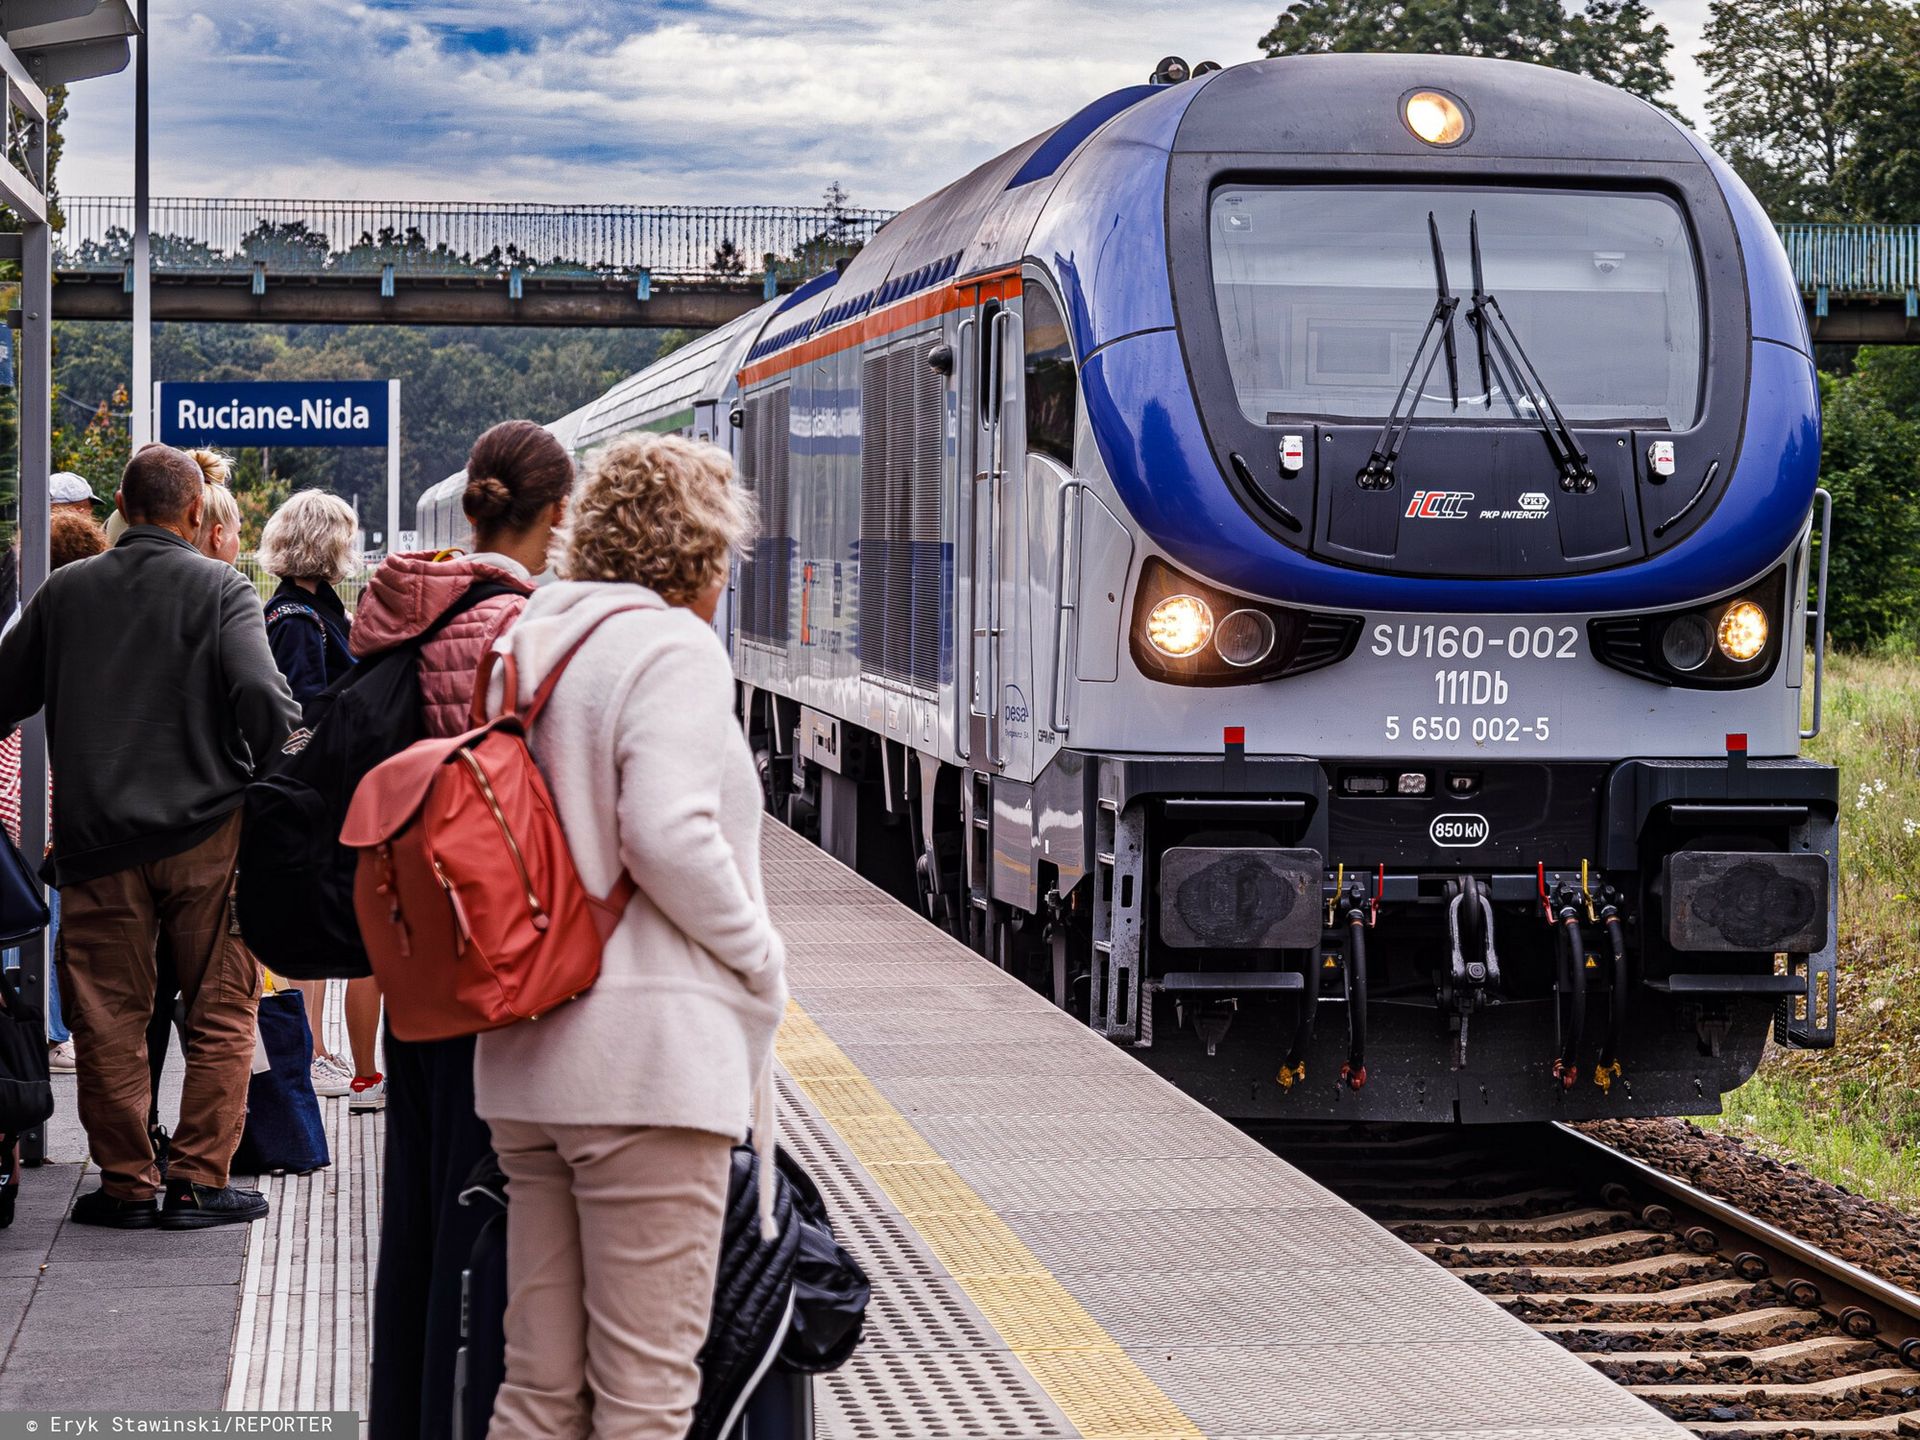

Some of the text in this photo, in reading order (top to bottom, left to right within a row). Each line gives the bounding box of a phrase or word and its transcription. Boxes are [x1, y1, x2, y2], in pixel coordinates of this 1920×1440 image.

[178, 398, 370, 430] Ruciane-Nida
[1479, 511, 1549, 519] PKP INTERCITY
[1371, 624, 1579, 659] SU160-002
[1434, 670, 1509, 705] 111Db
[1005, 705, 1027, 725] pesa
[1385, 716, 1550, 742] 5 650 002-5
[1435, 822, 1484, 838] 850 kN
